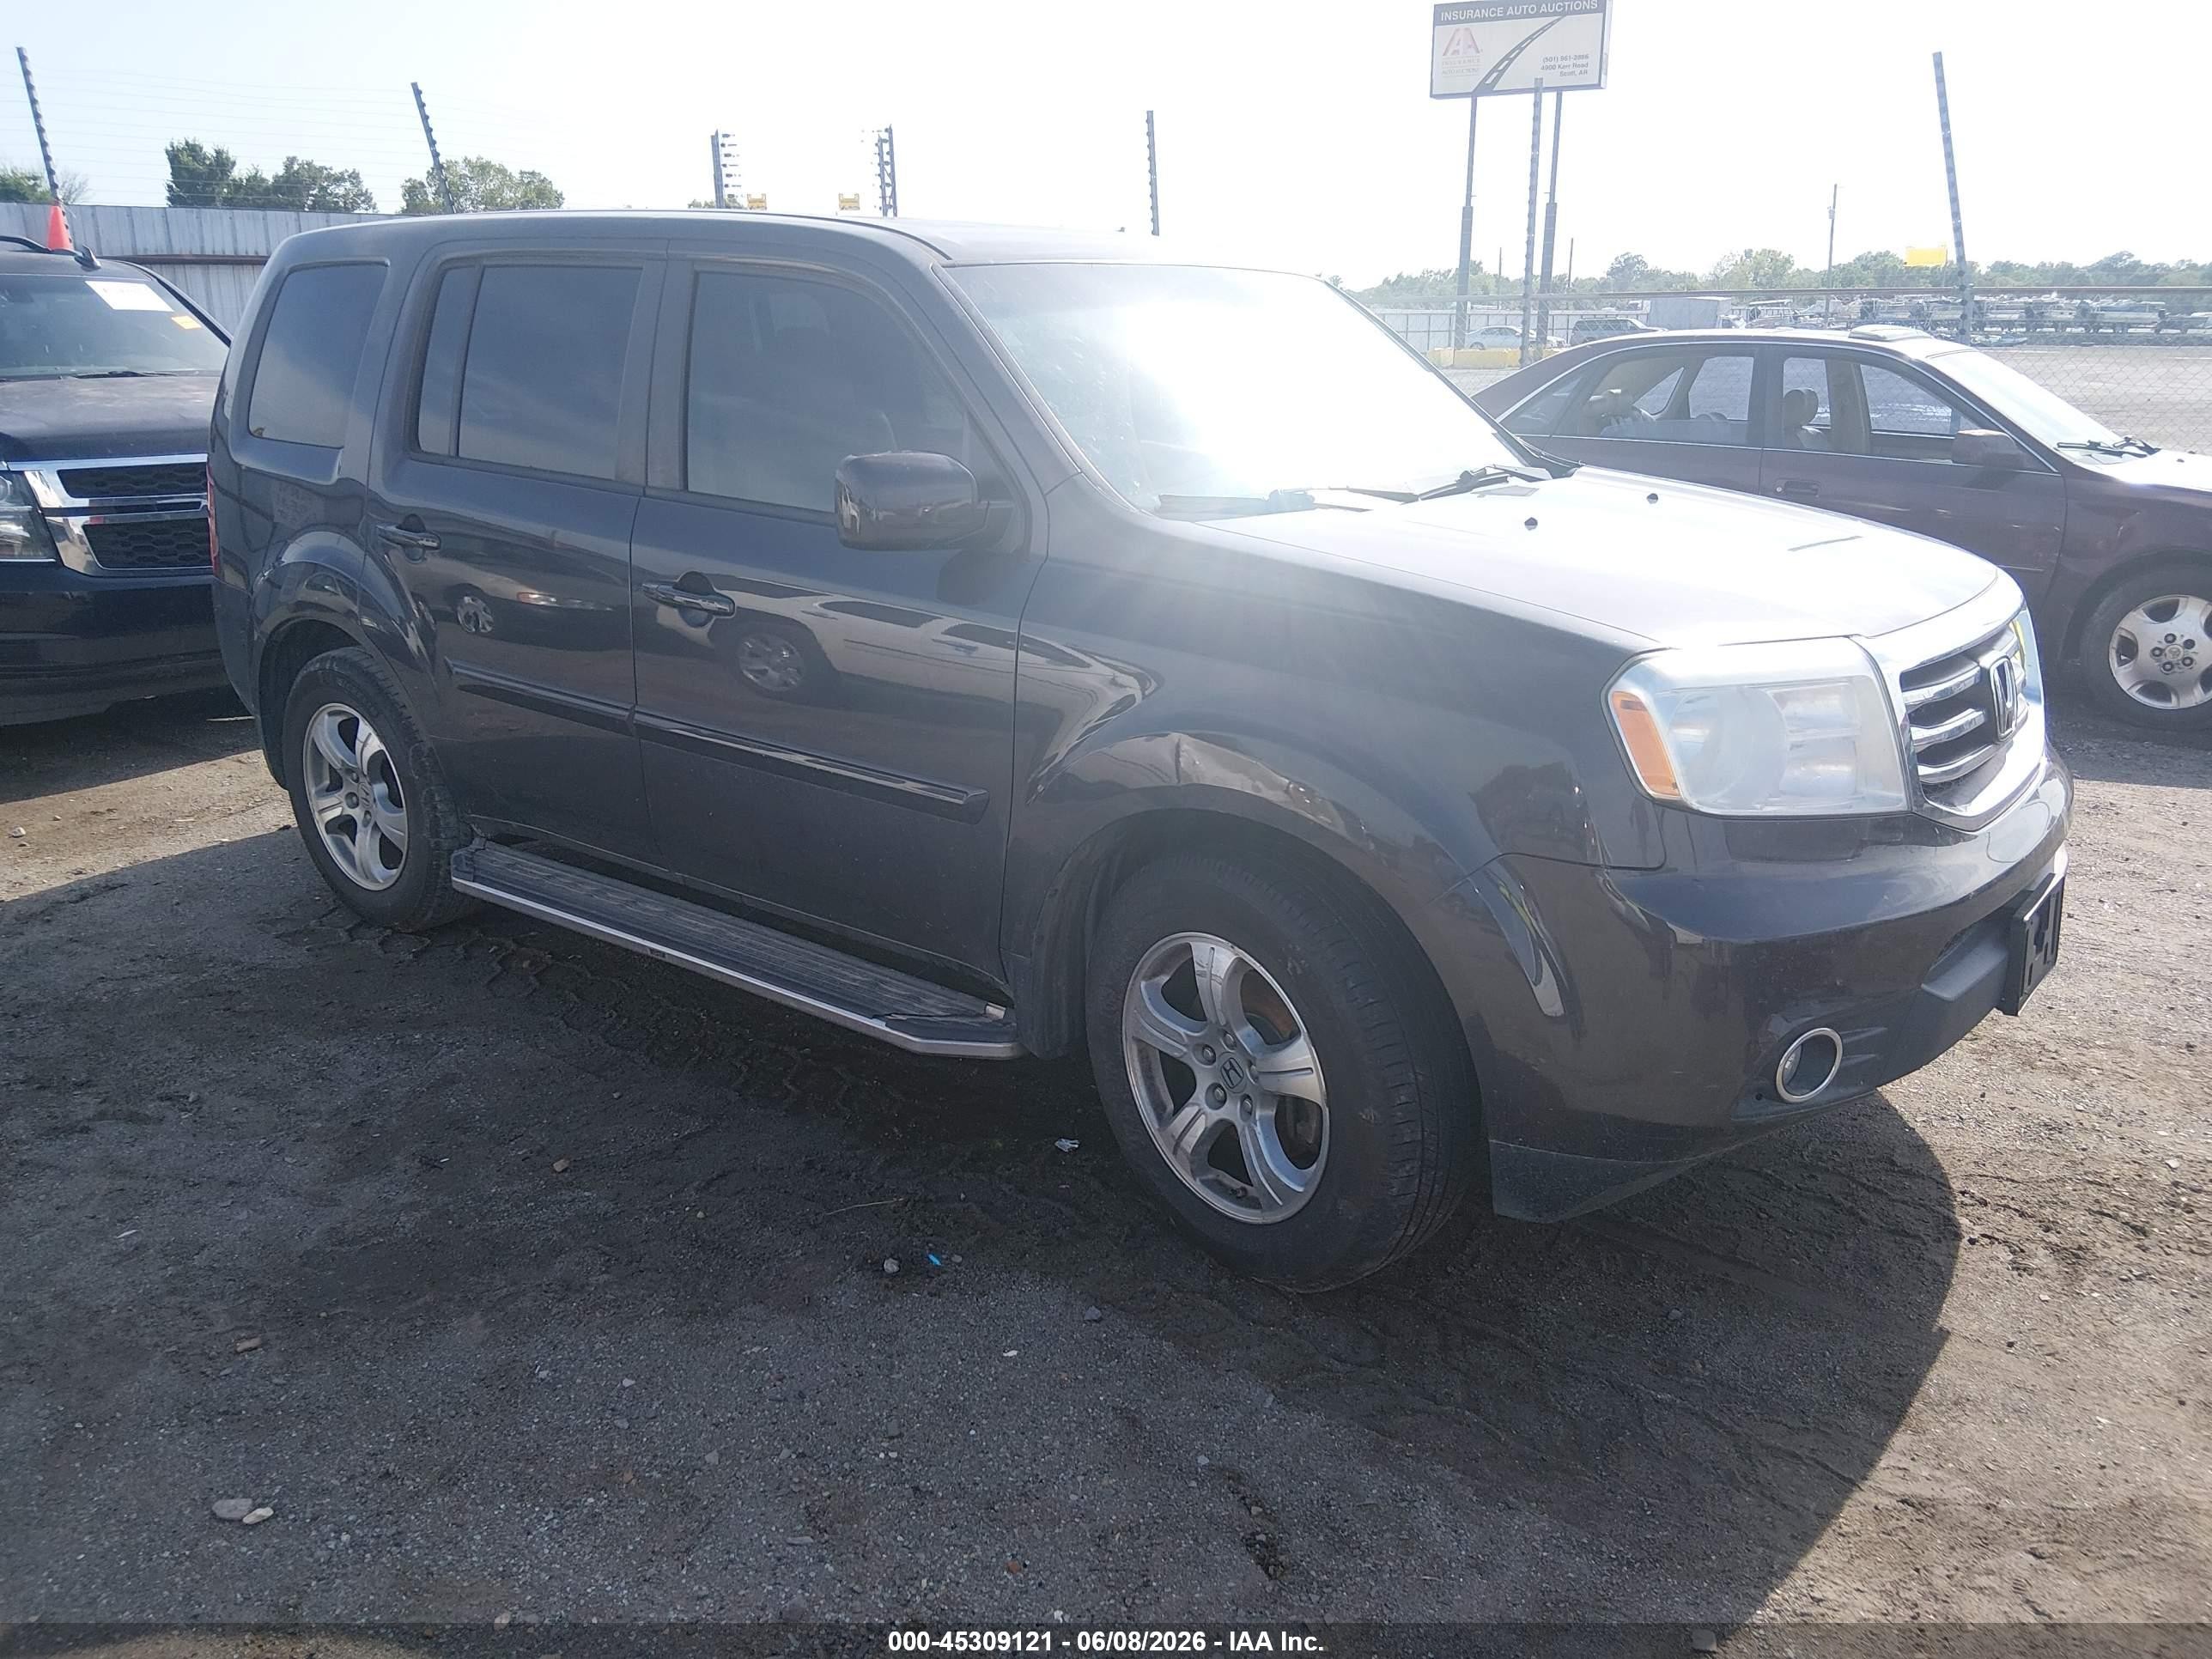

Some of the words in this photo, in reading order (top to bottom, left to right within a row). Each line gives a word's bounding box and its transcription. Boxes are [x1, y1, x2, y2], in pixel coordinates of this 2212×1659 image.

[1441, 7, 1504, 21] INSURANCE
[1507, 4, 1537, 15] AUTO
[1540, 0, 1598, 14] AUCTIONS
